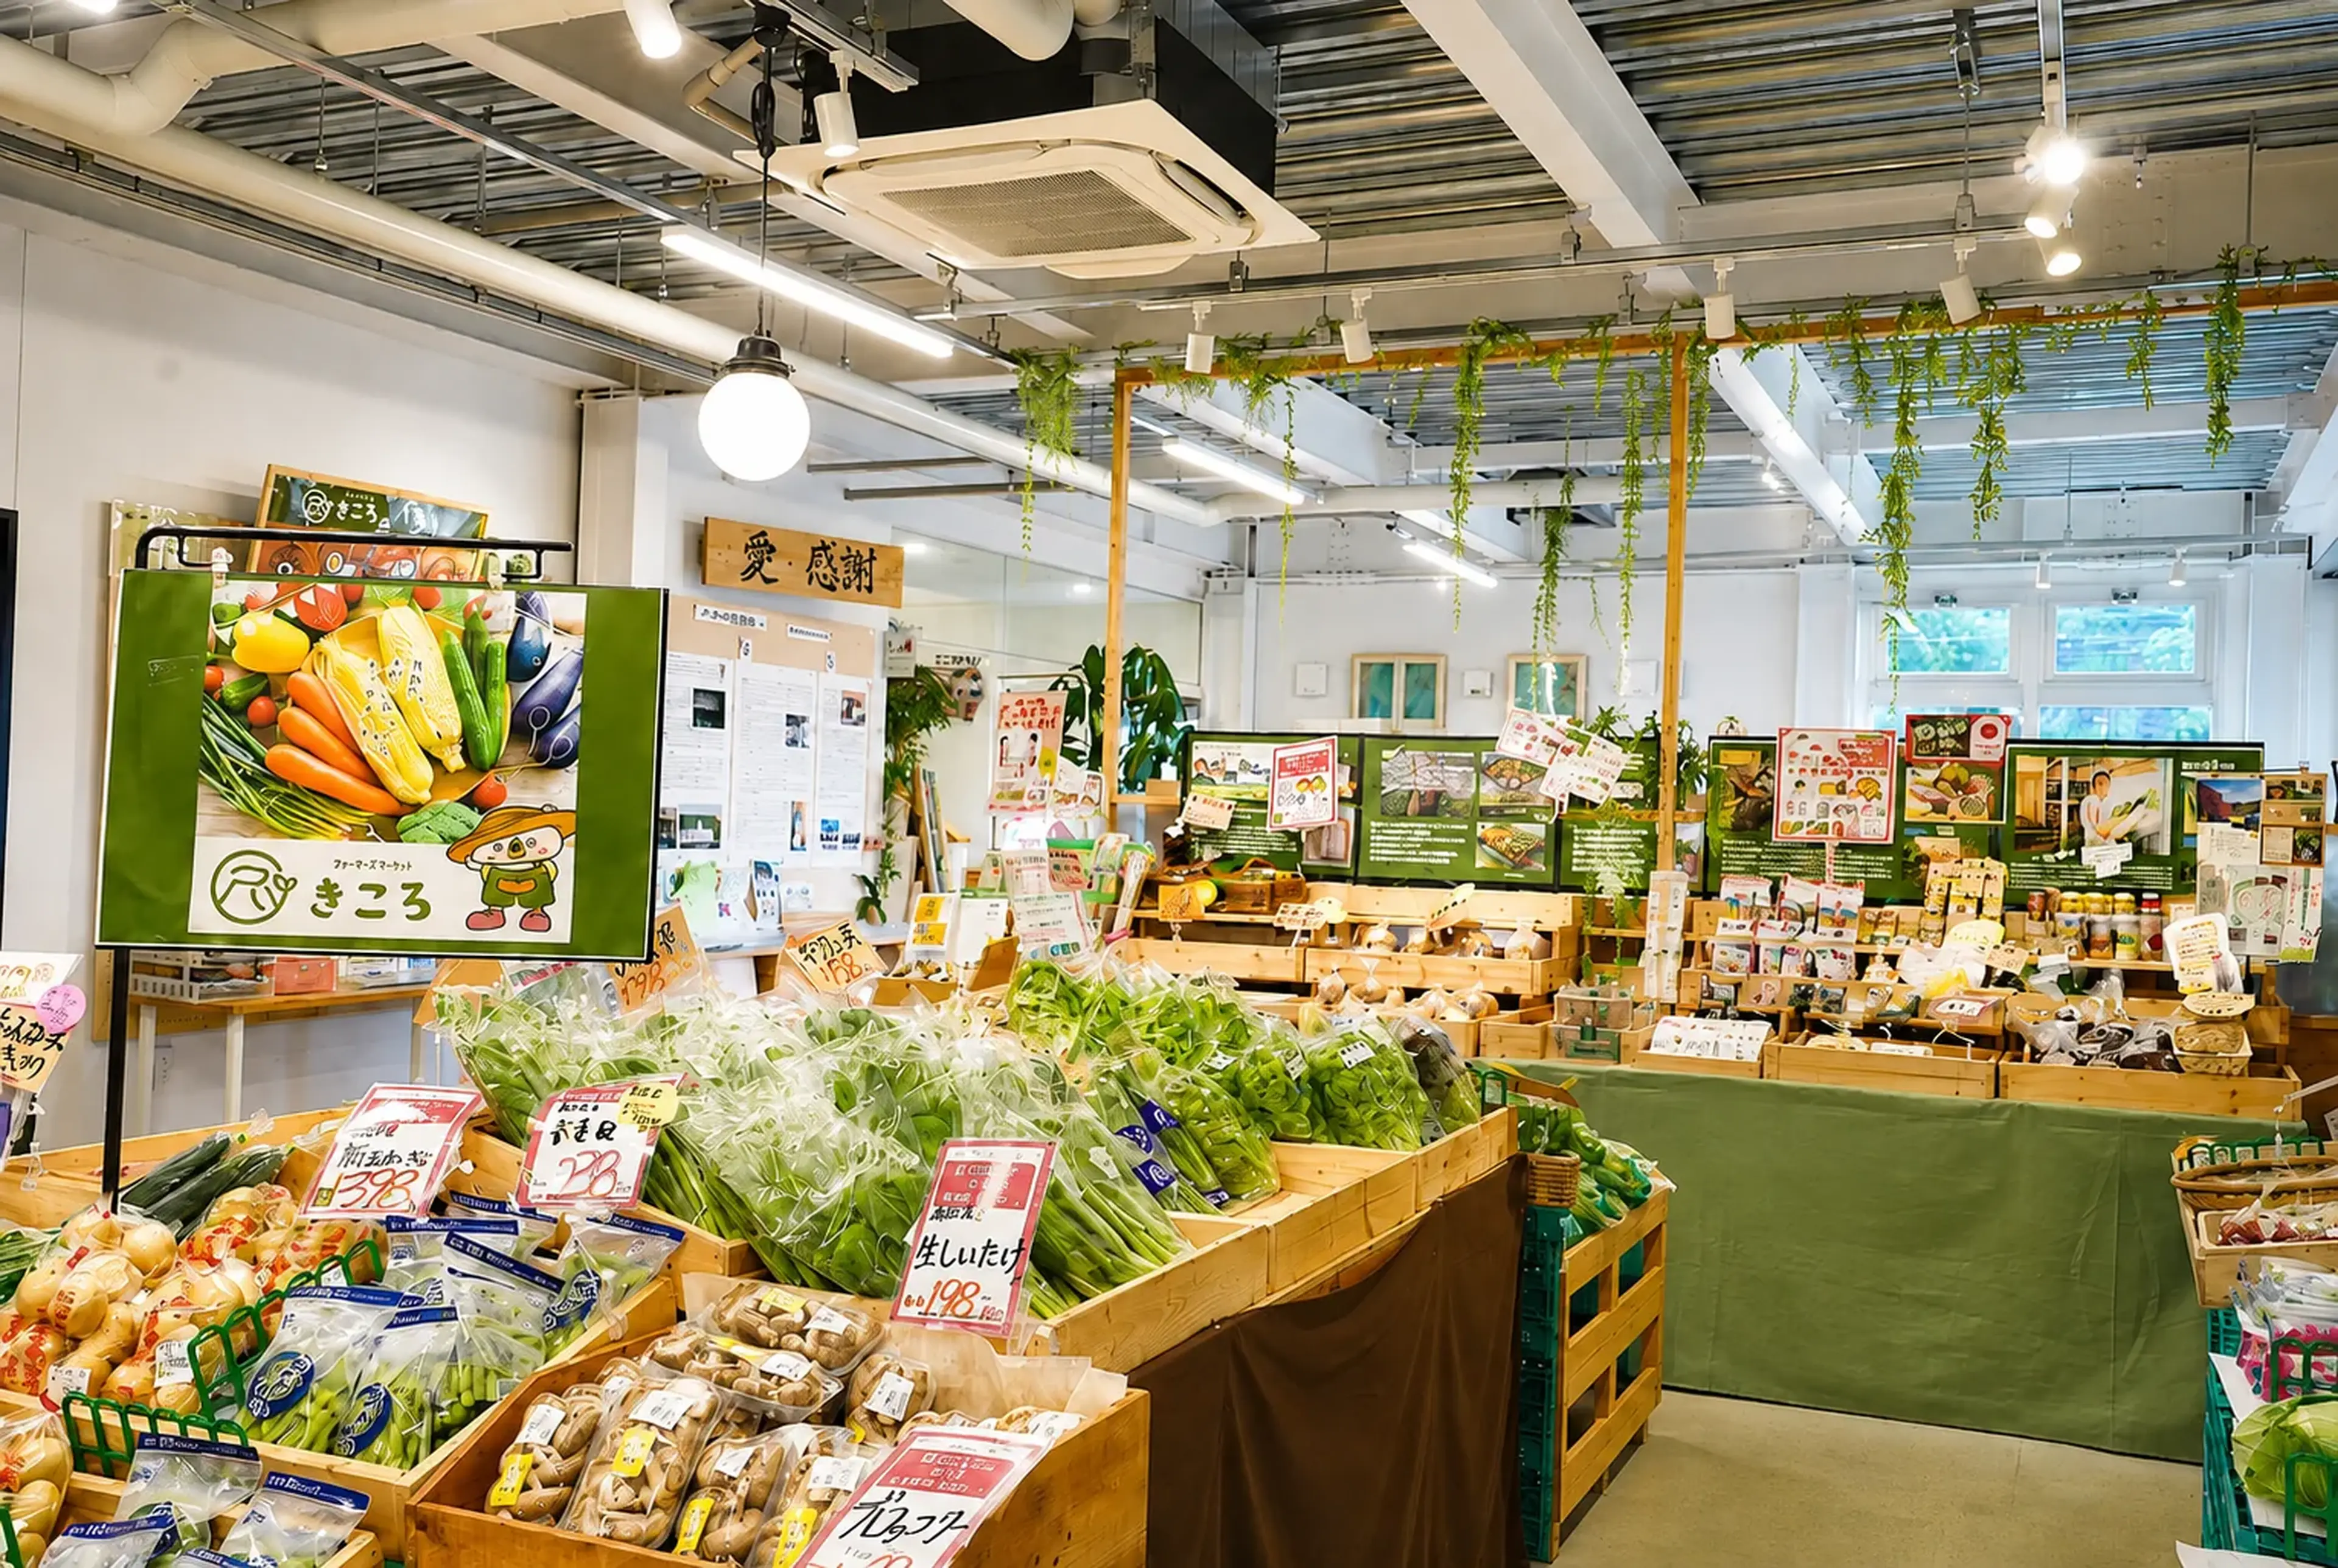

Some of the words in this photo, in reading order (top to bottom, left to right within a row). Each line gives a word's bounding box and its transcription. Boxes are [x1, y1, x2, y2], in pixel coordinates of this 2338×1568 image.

[740, 530, 877, 594] 愛・感謝
[310, 877, 432, 921] きころ
[914, 1233, 1025, 1274] 生しいたけ
[924, 1279, 981, 1318] 198
